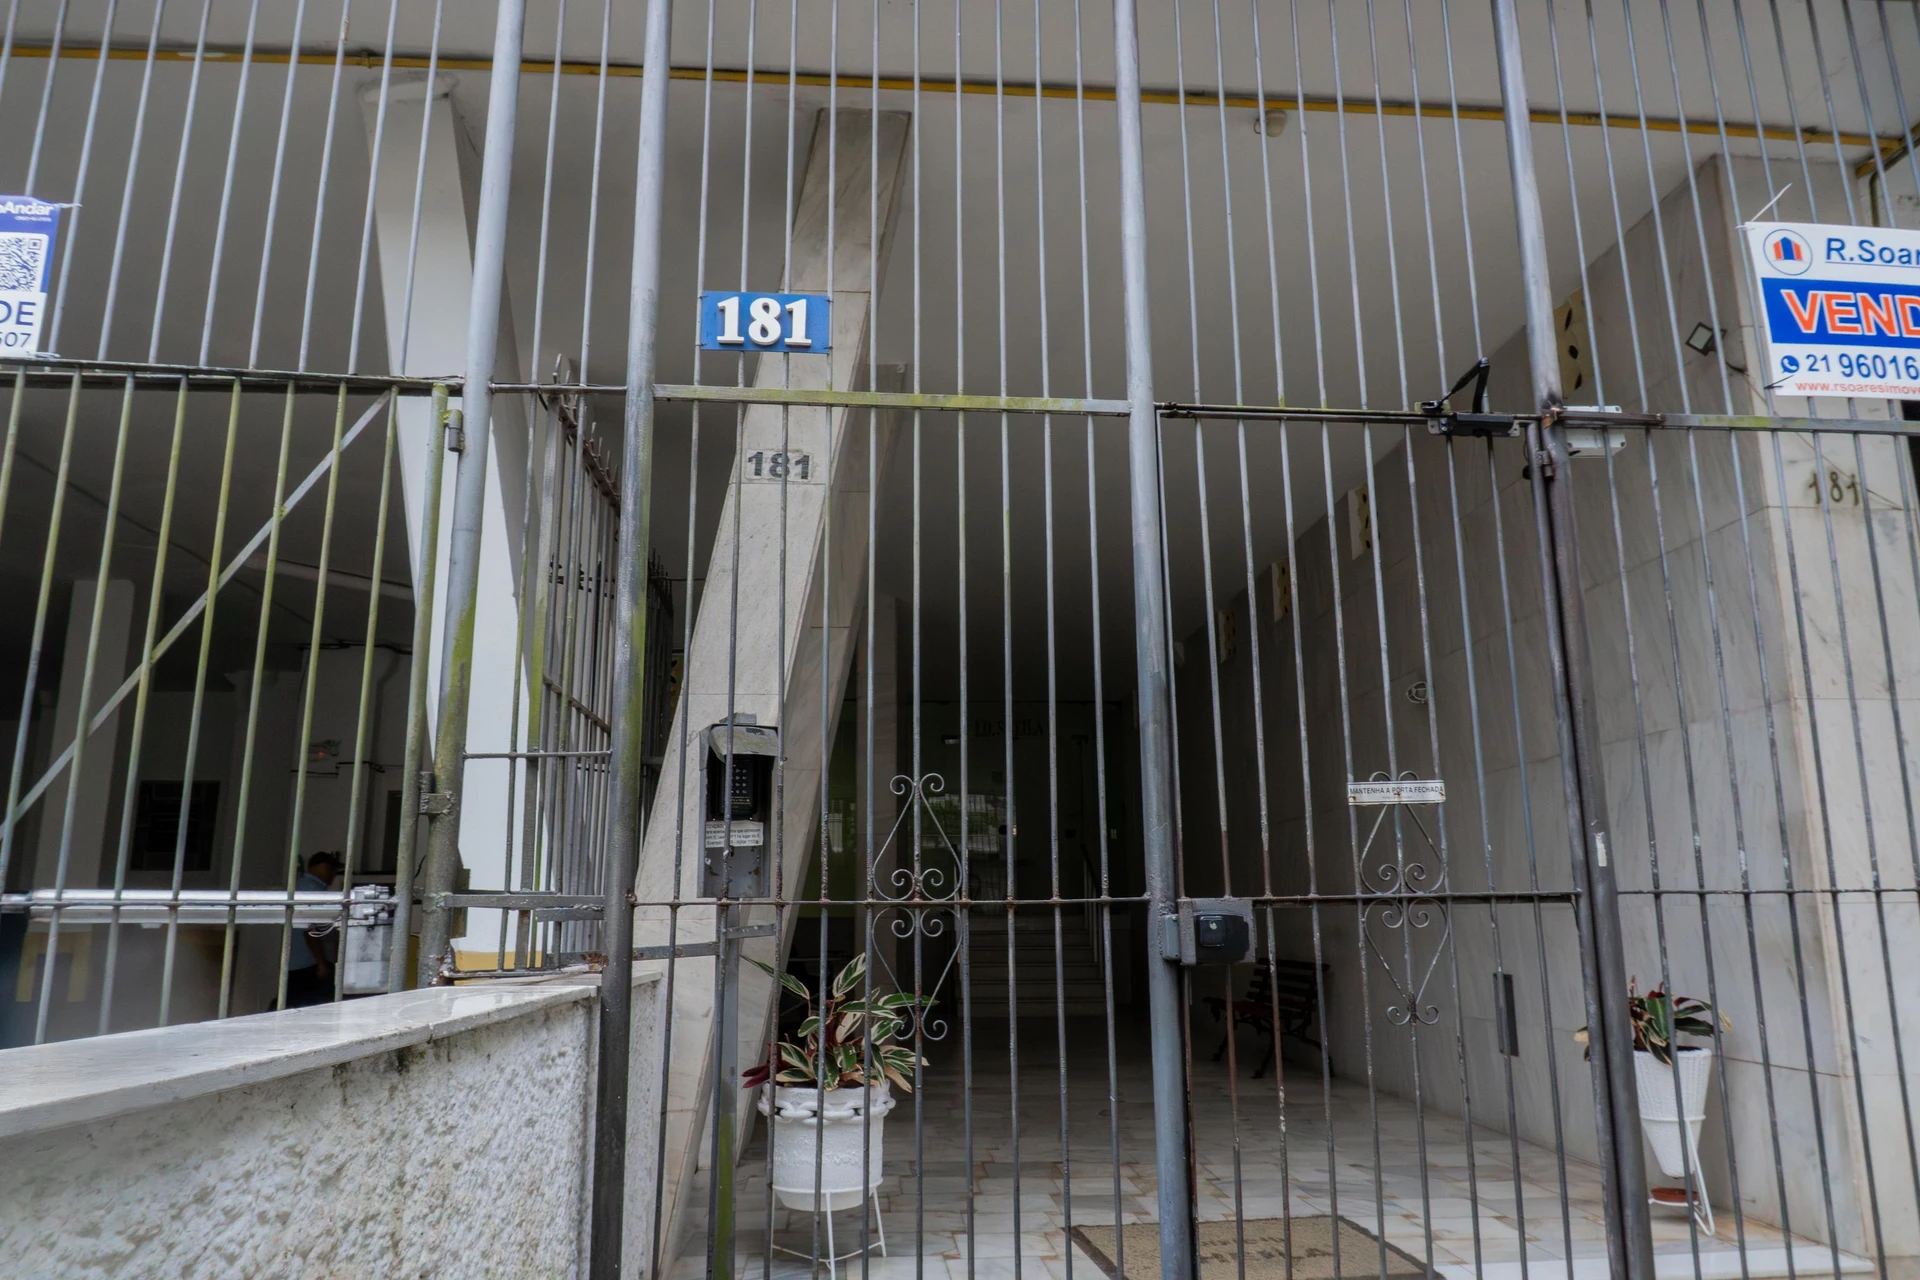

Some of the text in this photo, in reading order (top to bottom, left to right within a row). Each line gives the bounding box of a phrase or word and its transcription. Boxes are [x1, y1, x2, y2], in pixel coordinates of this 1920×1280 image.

[717, 296, 812, 346] 181
[0, 331, 32, 347] 07
[1806, 354, 1831, 372] 21
[748, 451, 810, 480] 181
[1809, 471, 1859, 506] 181
[1392, 786, 1413, 794] PORTA
[1414, 785, 1443, 793] FECHADA
